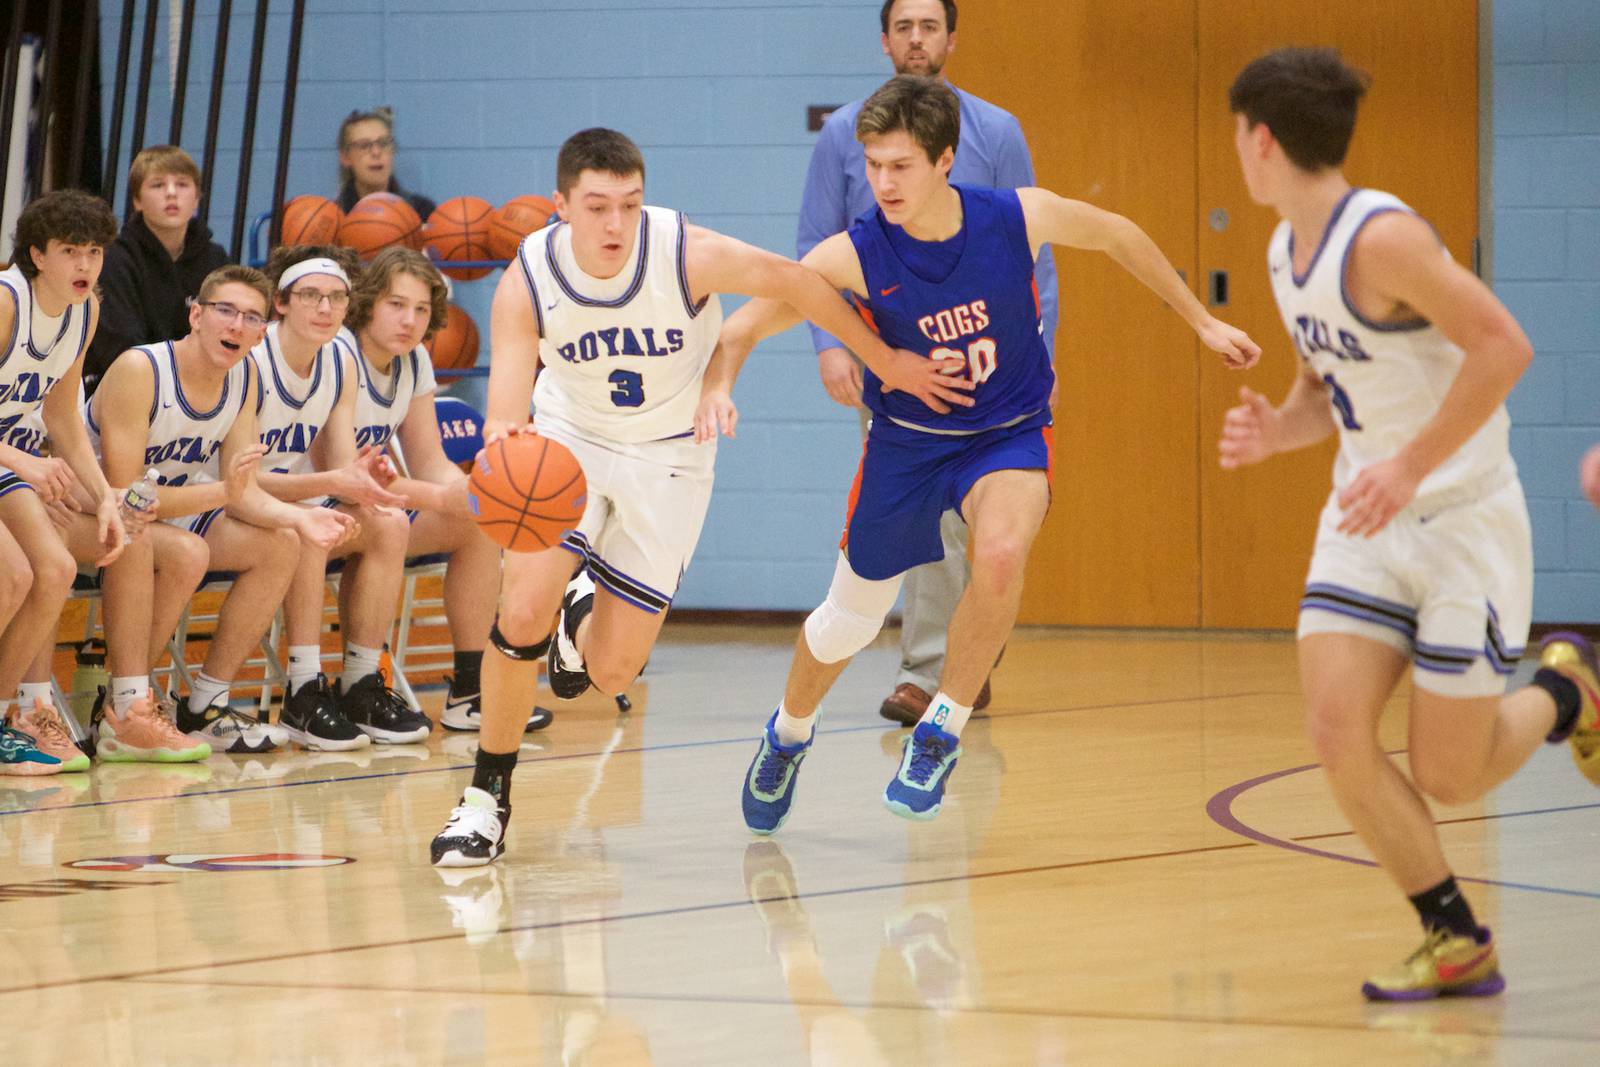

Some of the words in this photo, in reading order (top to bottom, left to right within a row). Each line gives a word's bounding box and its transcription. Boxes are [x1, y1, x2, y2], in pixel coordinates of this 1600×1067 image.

[917, 299, 990, 343] COGS
[557, 326, 684, 363] ROYALS
[608, 369, 645, 407] 3
